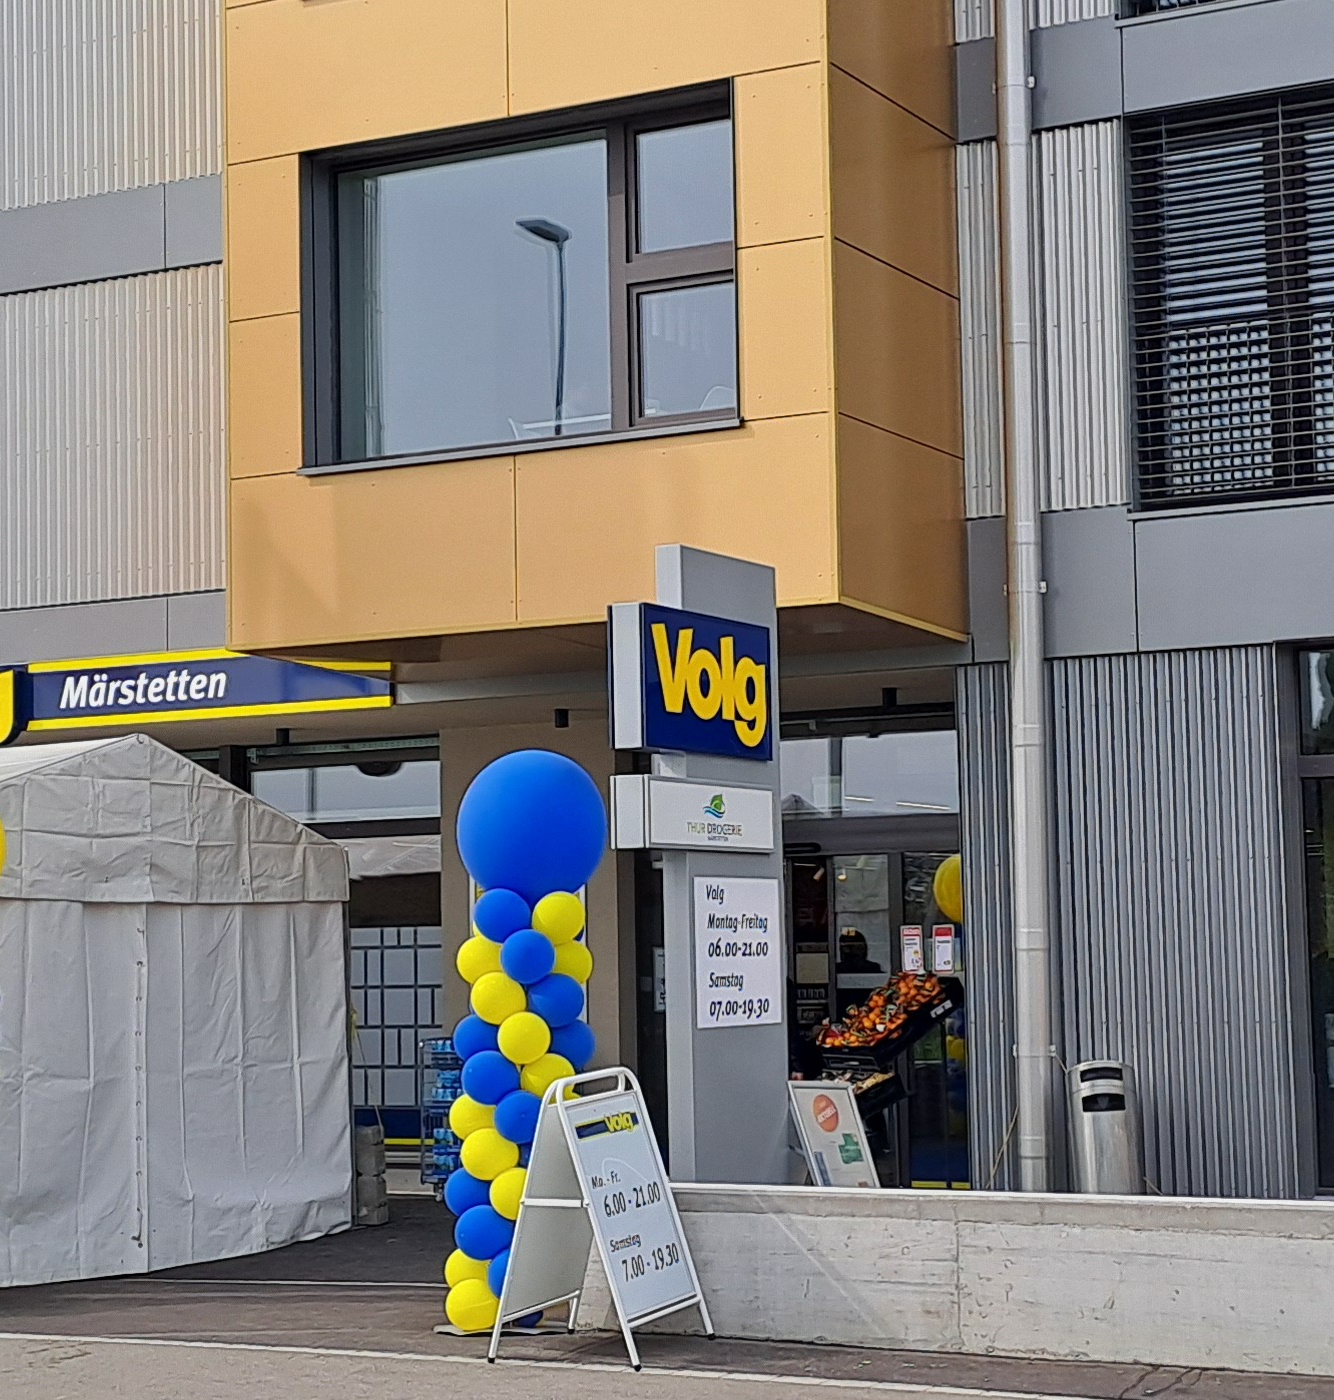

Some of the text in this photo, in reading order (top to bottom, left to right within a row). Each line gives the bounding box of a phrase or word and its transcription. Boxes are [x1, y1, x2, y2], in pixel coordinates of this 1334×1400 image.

[59, 671, 227, 710] Märstetten
[651, 623, 767, 748] Volg
[705, 884, 725, 905] Volg
[707, 912, 768, 933] Montag-Freitag
[708, 937, 769, 957] 06.00-21.00
[708, 971, 744, 991] Samstag
[709, 998, 770, 1021] 07.00-19.30
[603, 1112, 635, 1133] Volg
[604, 1191, 627, 1217] 6.00
[632, 1181, 661, 1208] 21.00
[610, 1234, 642, 1253] Samstag
[621, 1254, 645, 1282] 7.00
[651, 1242, 680, 1270] 19.30
